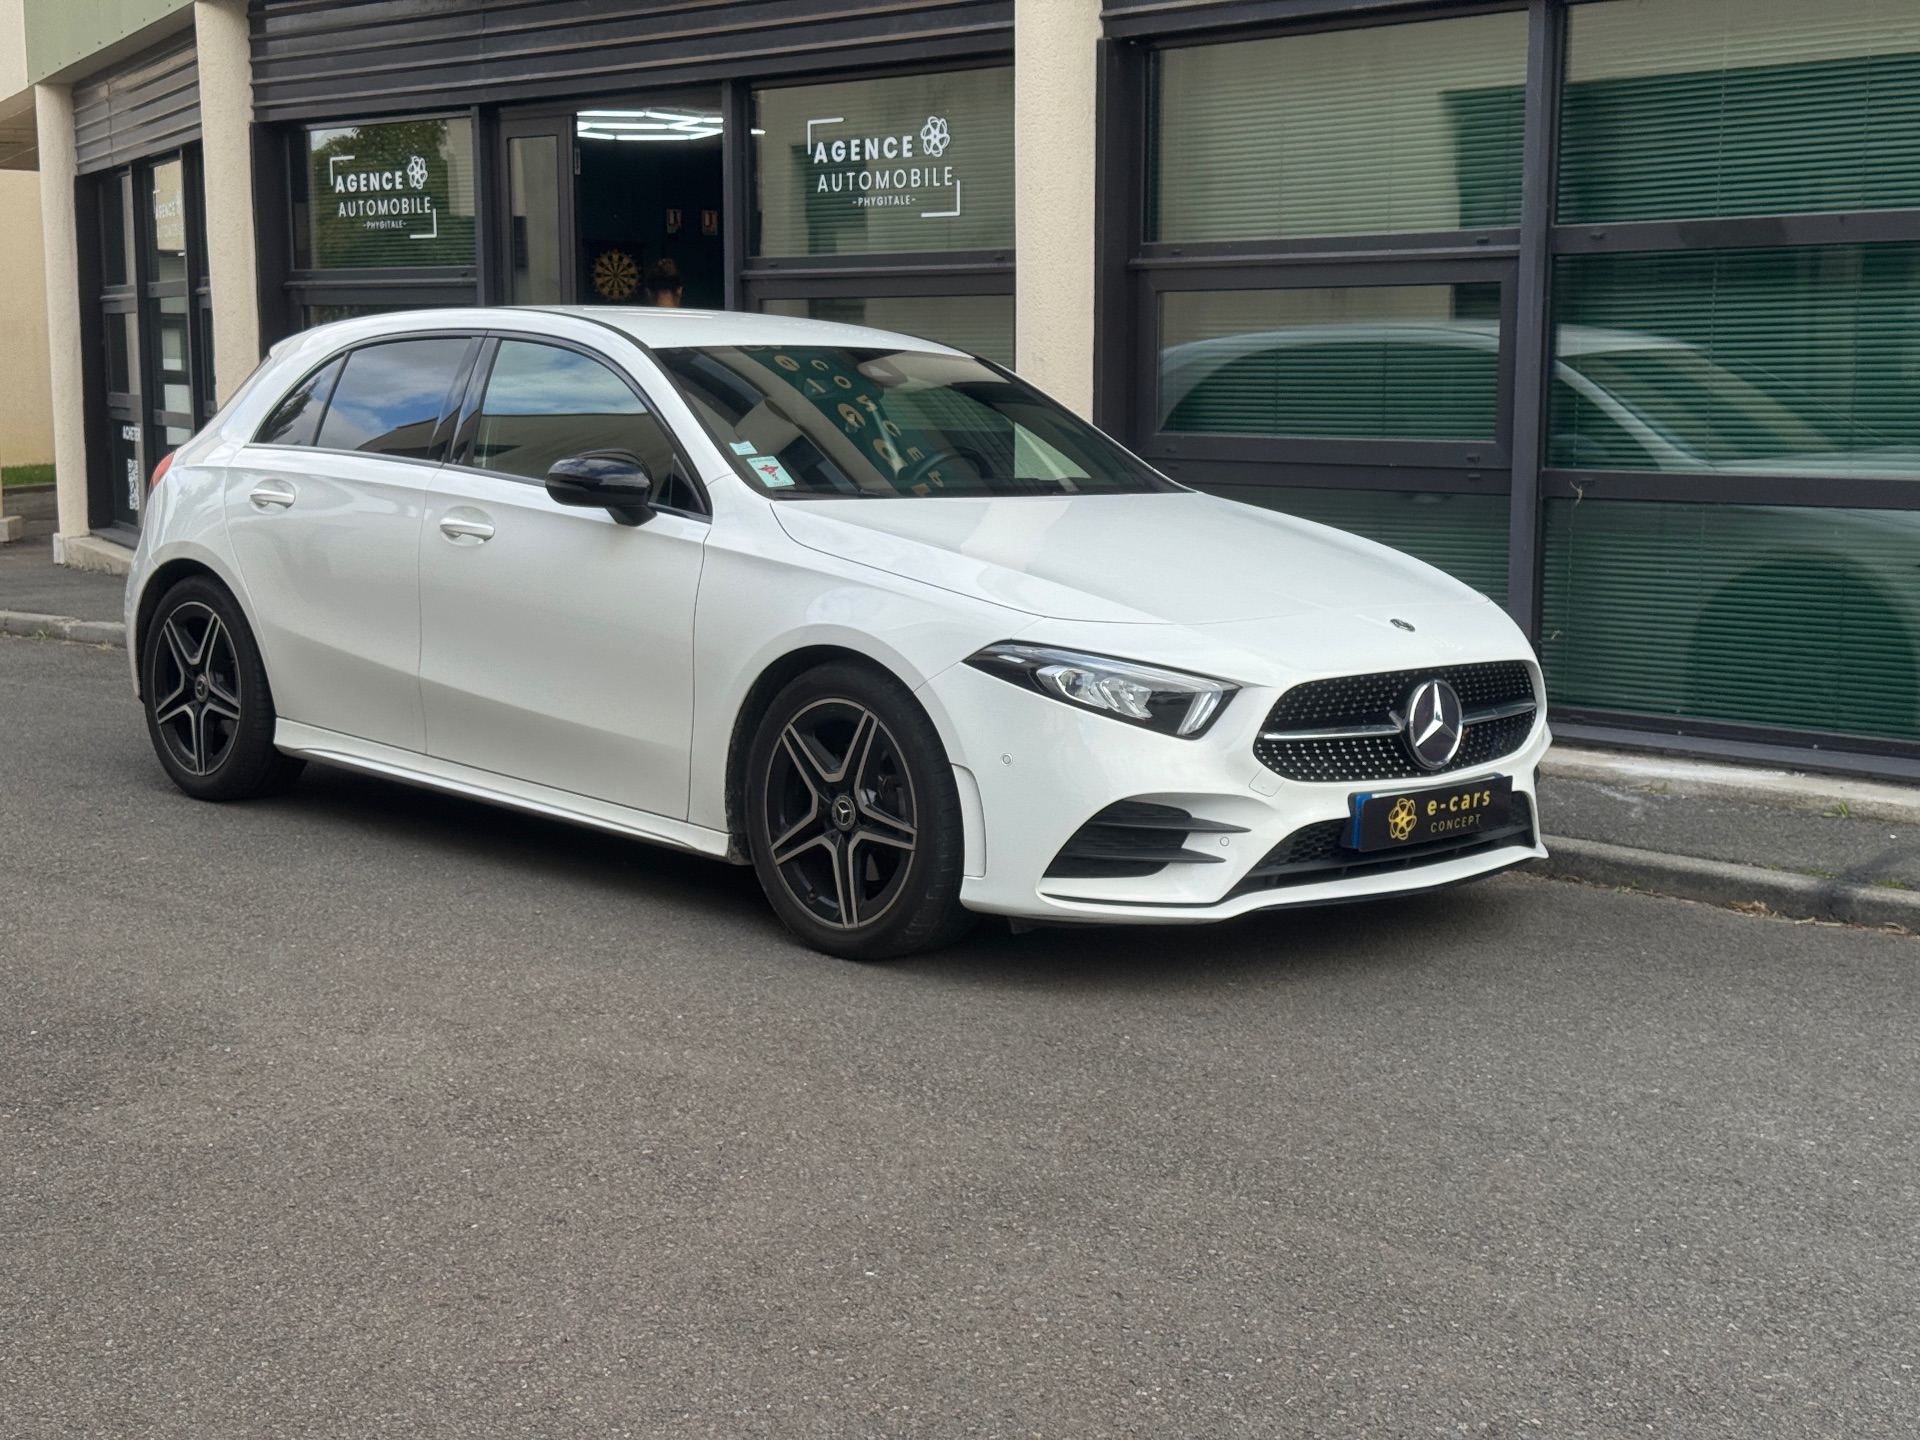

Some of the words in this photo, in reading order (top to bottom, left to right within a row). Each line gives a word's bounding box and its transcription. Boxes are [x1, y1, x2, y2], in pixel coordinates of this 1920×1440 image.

[813, 135, 913, 164] AGENCE
[335, 171, 404, 194] AGENCE
[817, 166, 953, 193] AUTOMOBILE
[338, 196, 432, 218] AUTOMOBILE
[1427, 790, 1491, 816] e-cars
[1430, 814, 1482, 833] CONCEPT
